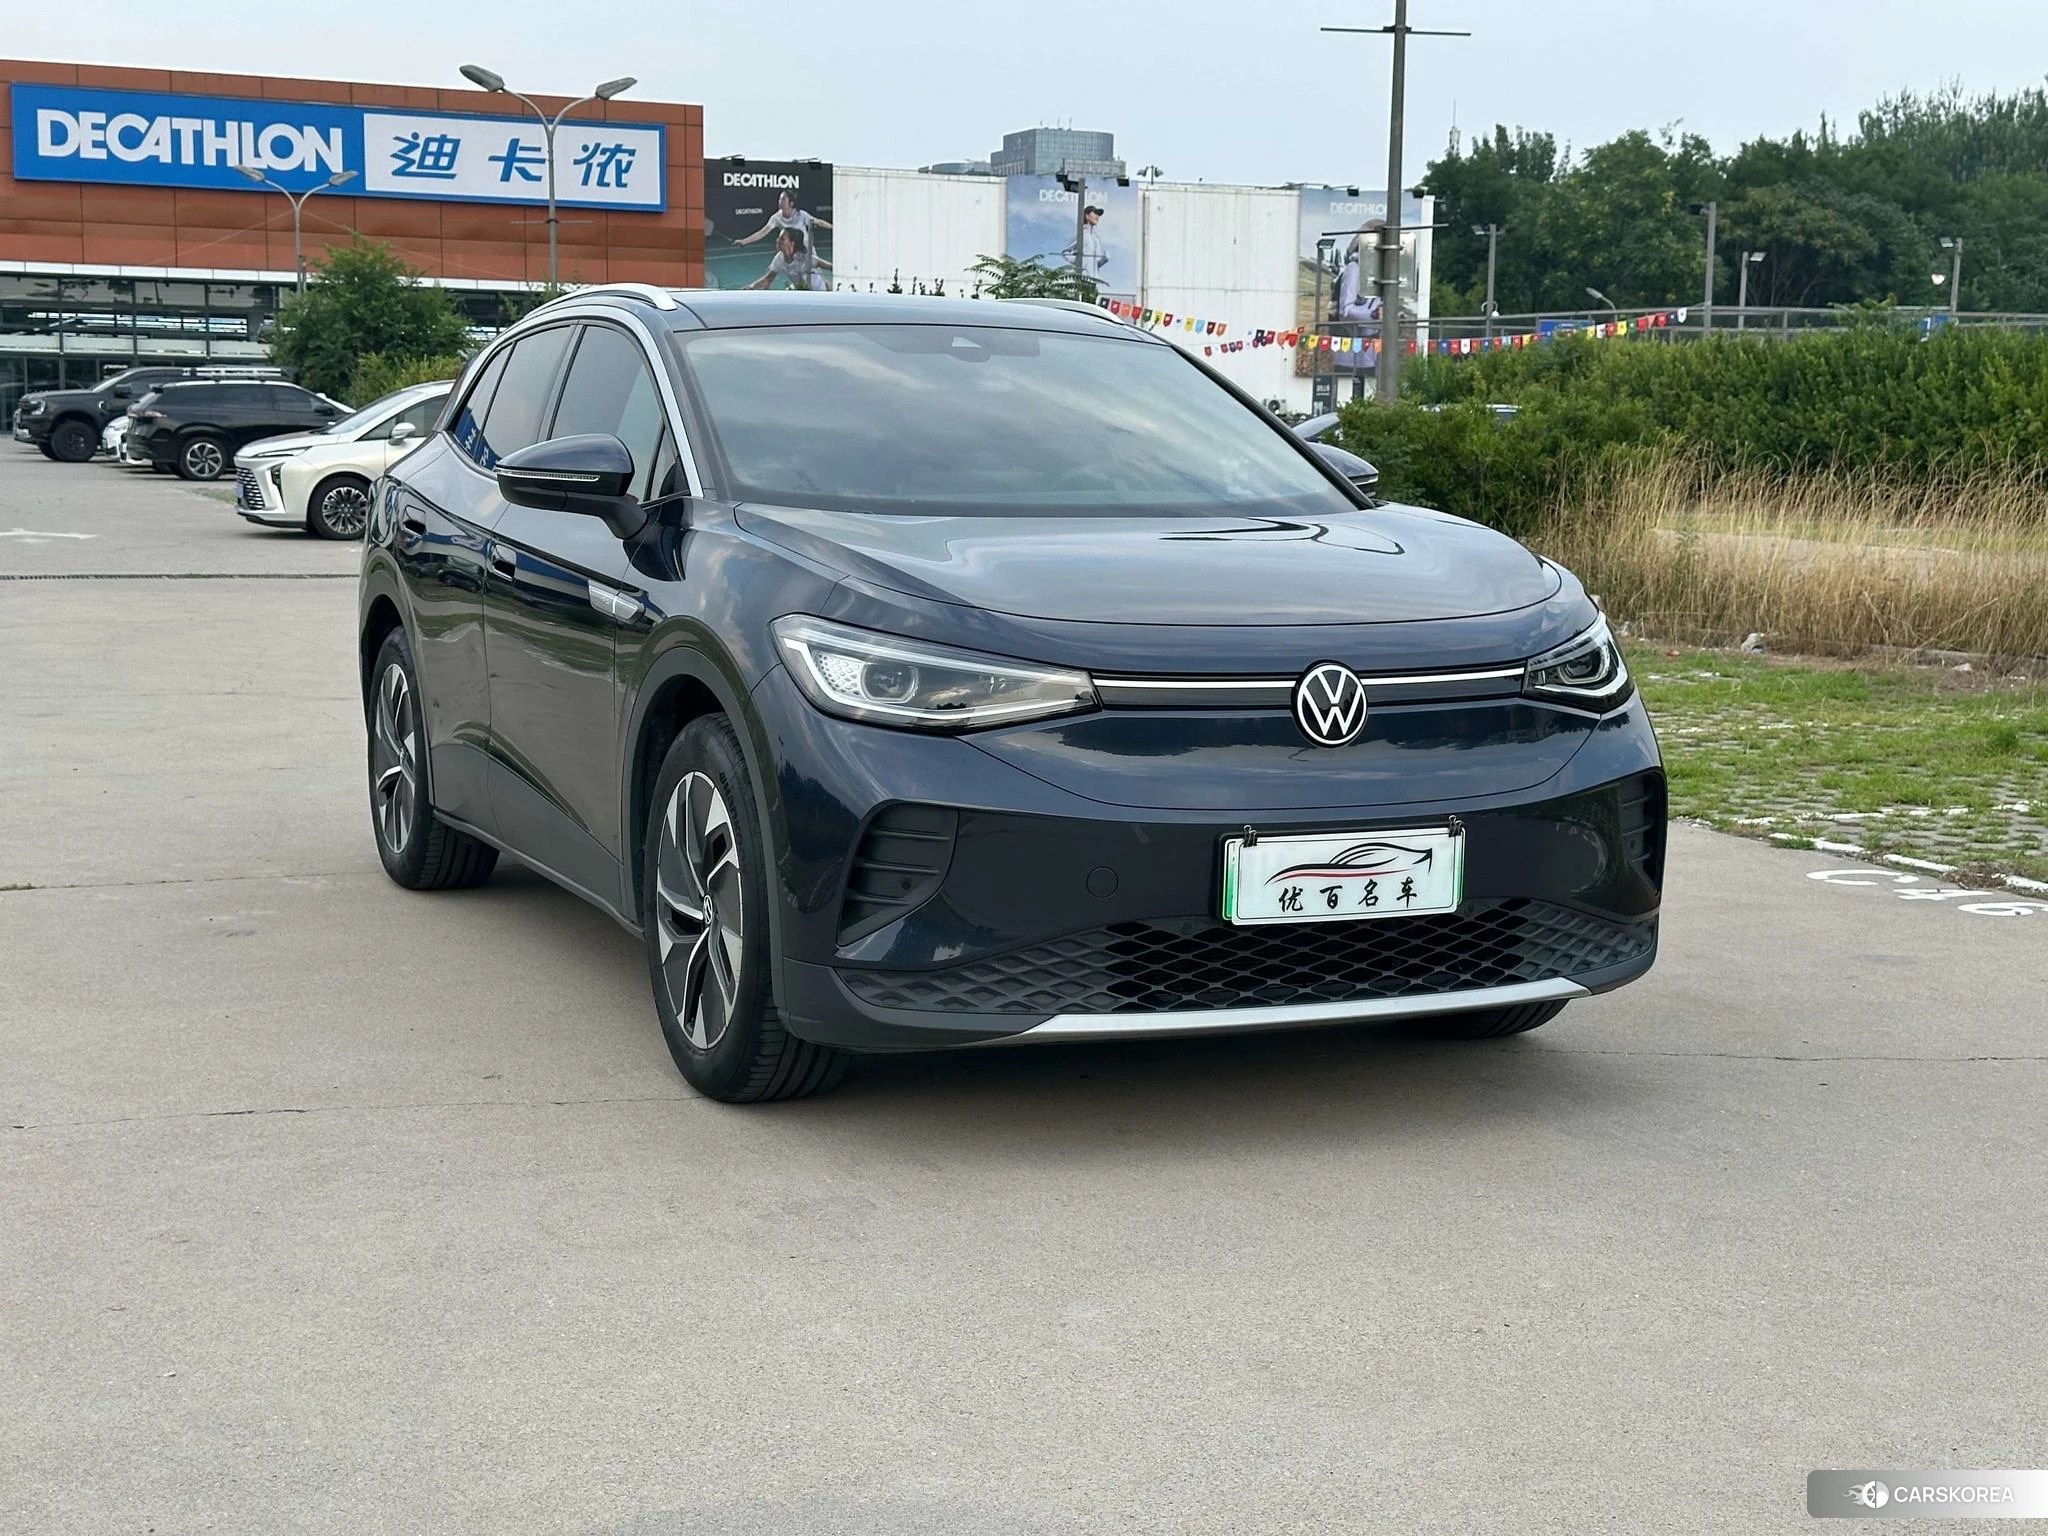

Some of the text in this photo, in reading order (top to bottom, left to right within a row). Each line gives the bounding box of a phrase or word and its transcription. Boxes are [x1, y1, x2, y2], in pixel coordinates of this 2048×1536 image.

[37, 108, 342, 172] DECATHLON
[391, 131, 635, 189] 迪卡侬
[723, 172, 799, 188] DECATHLON
[1039, 189, 1107, 204] DECATON
[1330, 202, 1387, 216] DECATHLO
[1278, 876, 1418, 912] 优百名车
